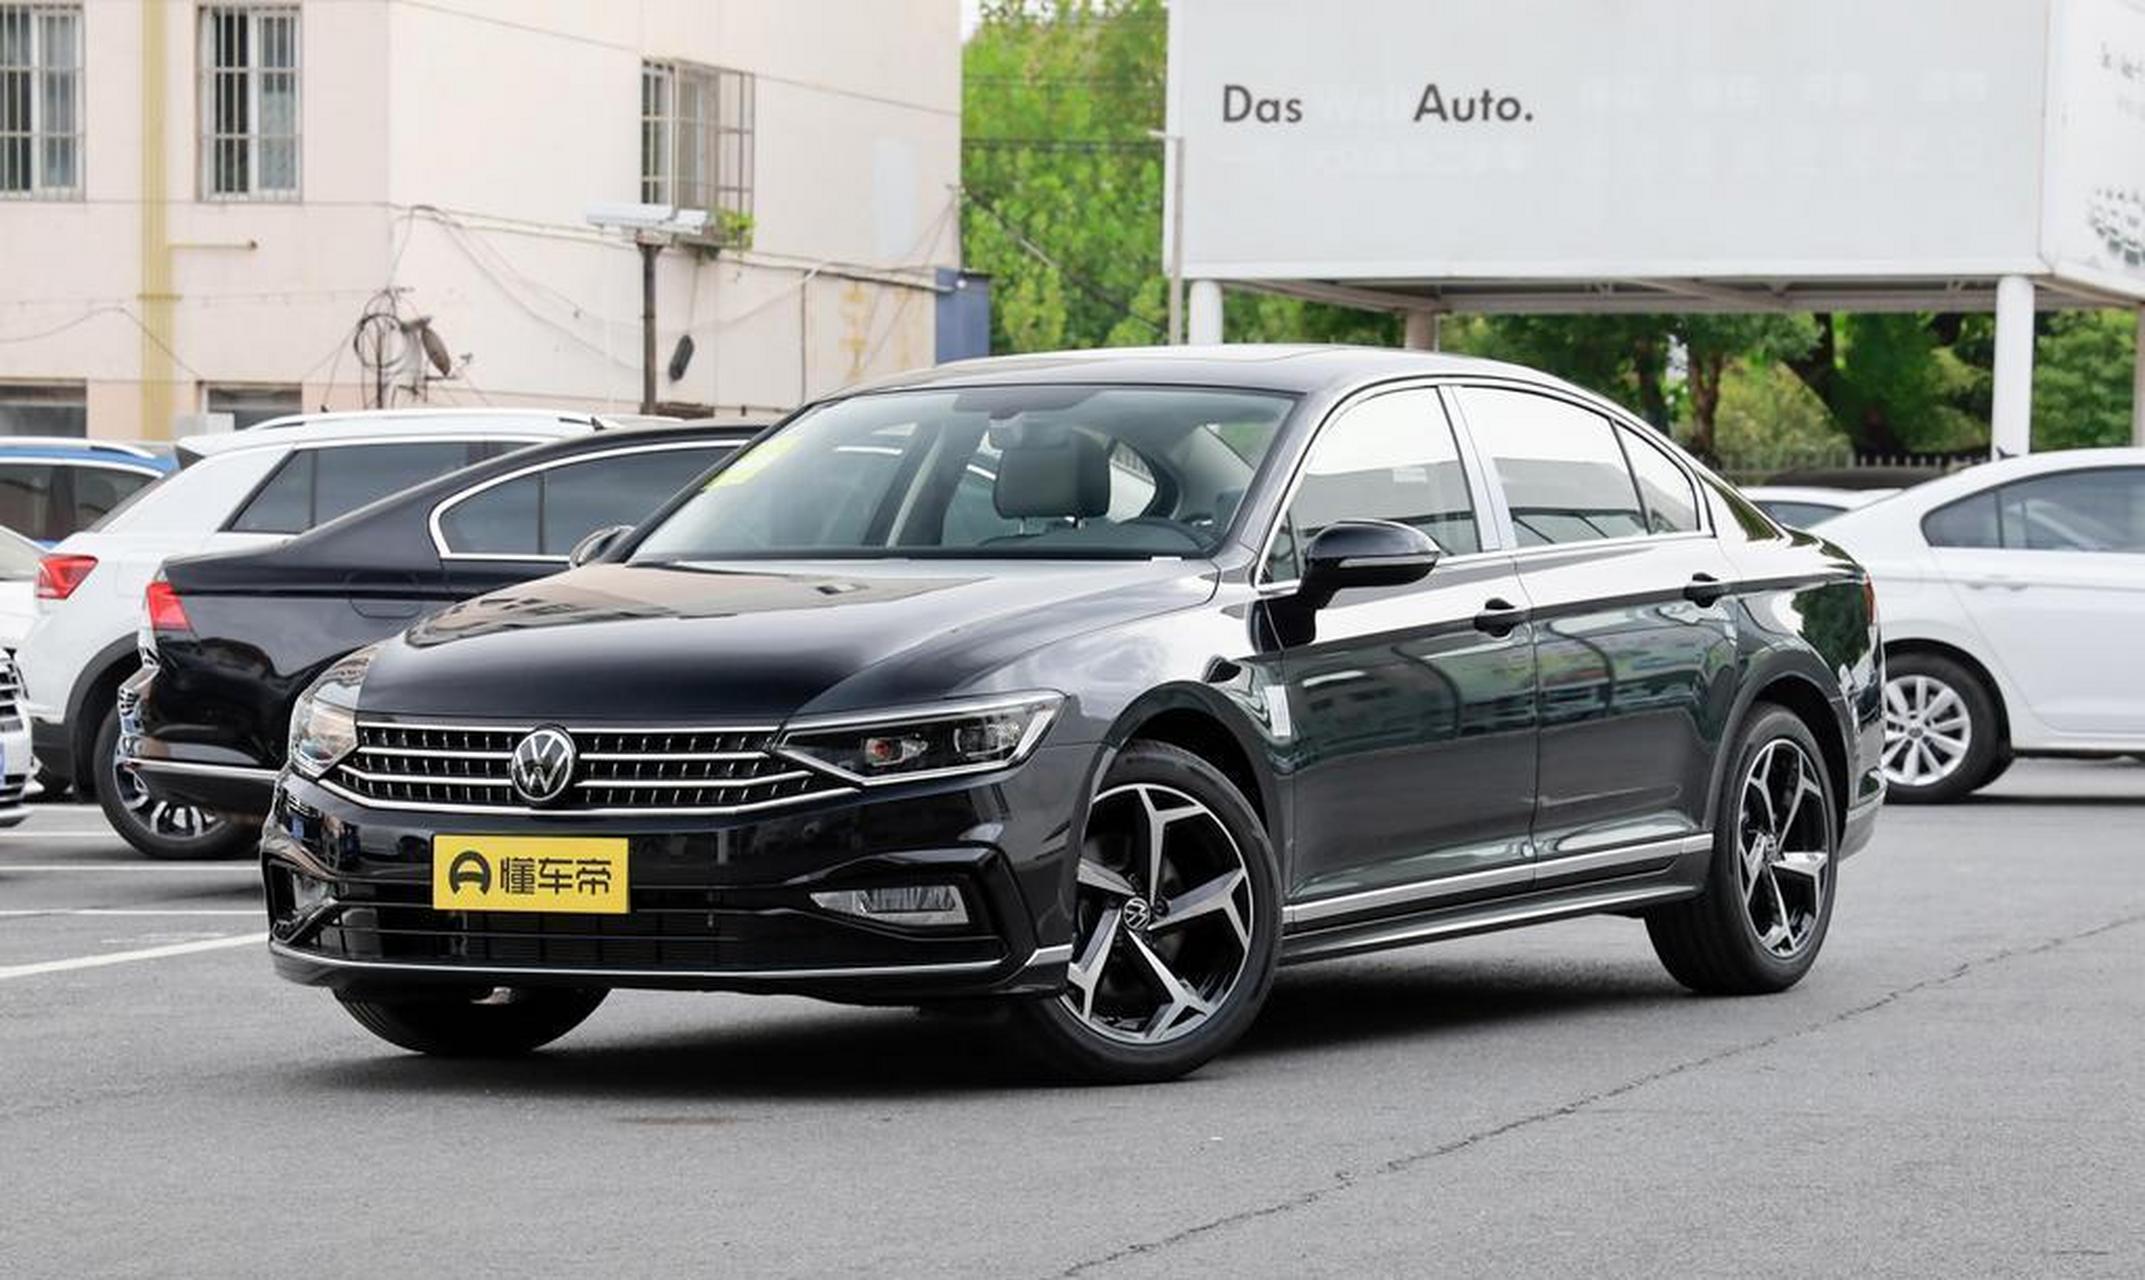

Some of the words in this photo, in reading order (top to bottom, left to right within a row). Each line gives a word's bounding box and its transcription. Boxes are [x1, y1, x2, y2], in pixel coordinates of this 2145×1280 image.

[1222, 84, 1303, 123] Das
[1413, 83, 1534, 123] Auto.
[500, 856, 612, 896] 懂车帝
